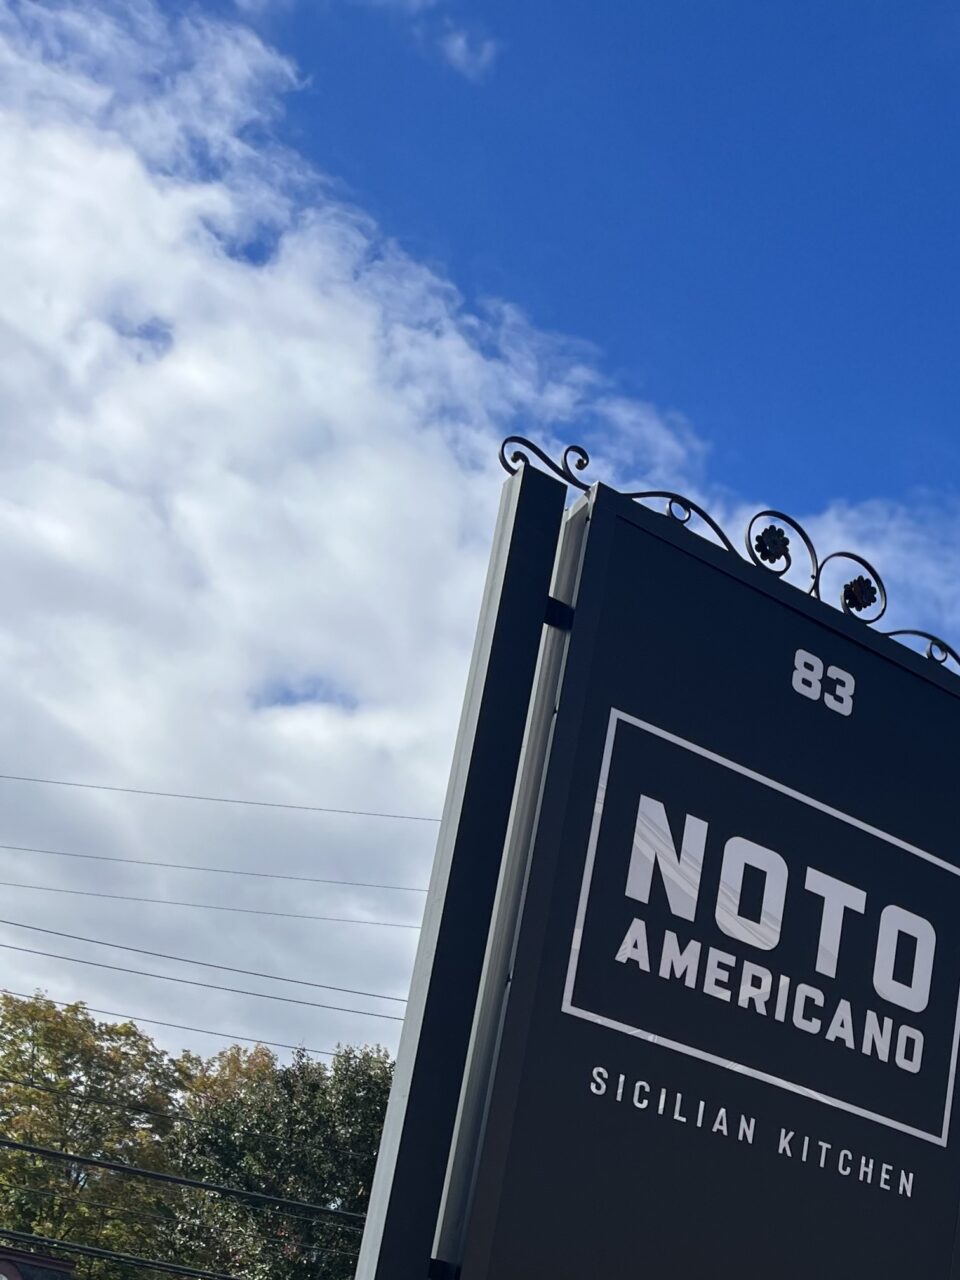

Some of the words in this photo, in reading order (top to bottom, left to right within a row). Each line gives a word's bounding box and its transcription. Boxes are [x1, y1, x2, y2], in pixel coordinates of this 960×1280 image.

[791, 648, 856, 717] 83
[624, 793, 937, 1013] NOTO
[614, 917, 925, 1074] AMERICANO
[589, 1066, 756, 1146] SICILIAN
[777, 1127, 915, 1198] KITCHEN
